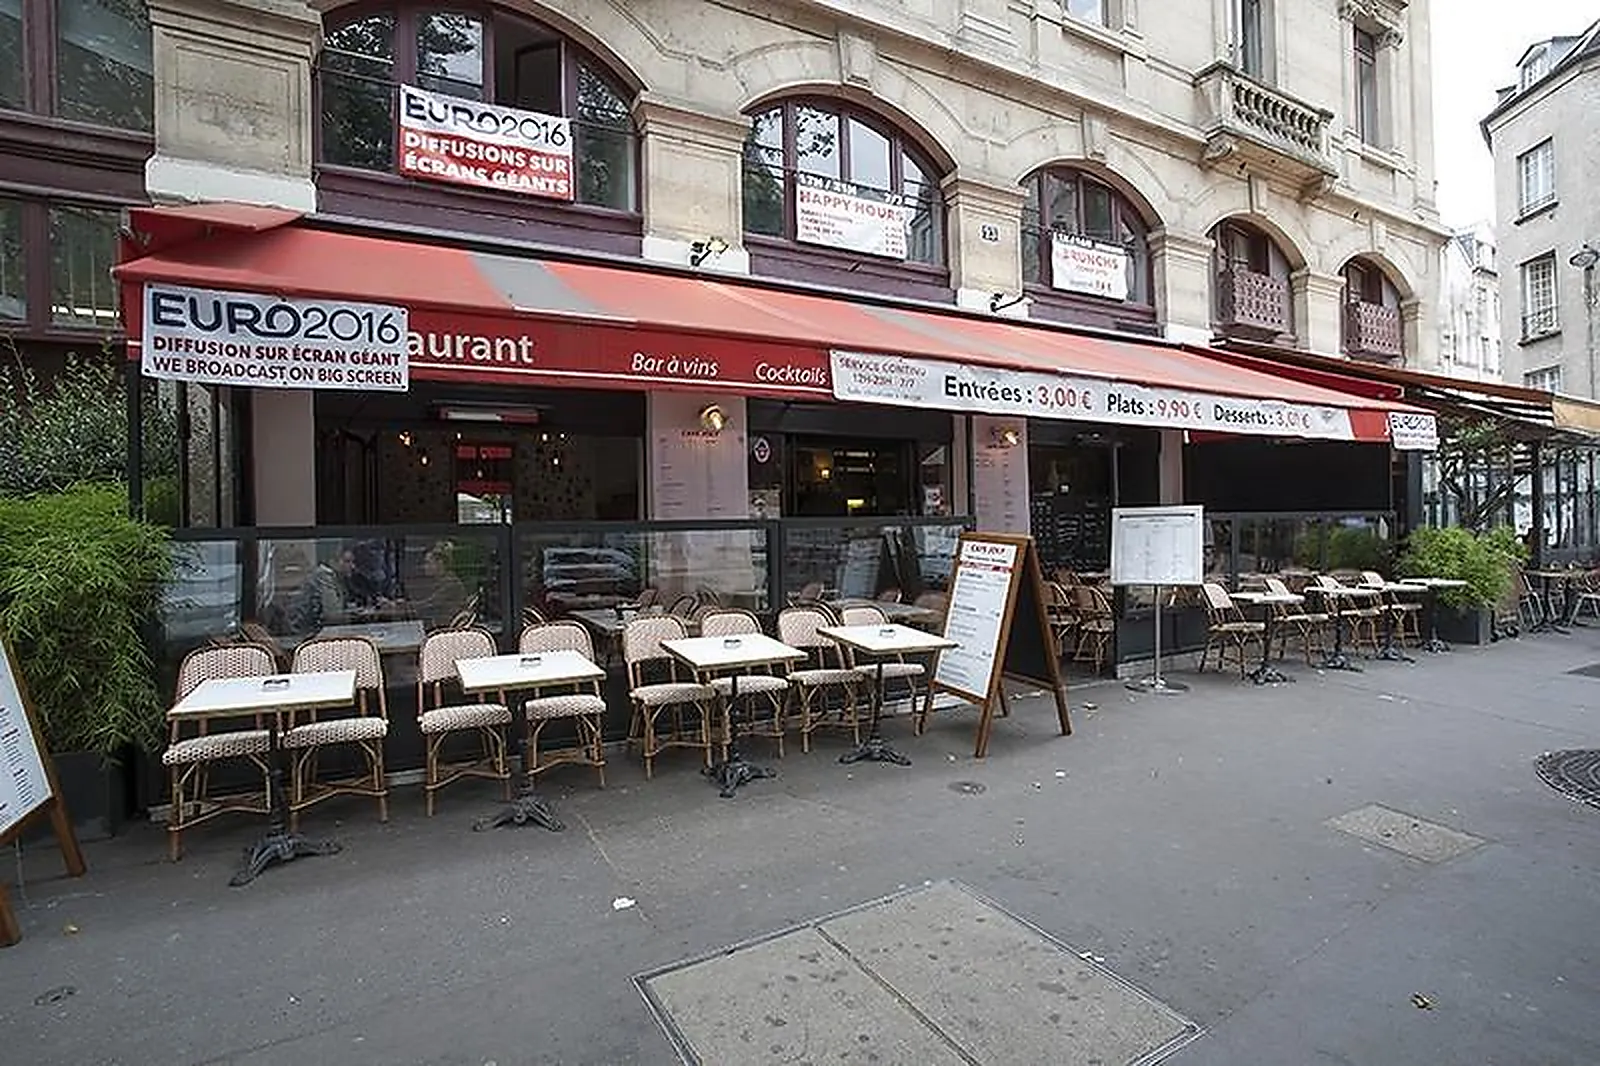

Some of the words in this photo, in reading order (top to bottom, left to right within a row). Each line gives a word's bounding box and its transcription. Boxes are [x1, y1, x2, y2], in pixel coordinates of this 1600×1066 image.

[405, 93, 567, 147] EURO2016
[405, 133, 528, 167] DIFFUSIONS
[530, 155, 568, 174] SUR
[405, 152, 488, 182] ÉCRANS
[493, 172, 569, 194] GÉANTS
[800, 191, 851, 211] HAPPY
[855, 202, 904, 222] HOURS
[152, 292, 400, 344] EURO2016
[153, 336, 251, 359] DIFFUSION
[255, 345, 288, 361] SUR
[292, 341, 346, 363] ÉCRAN
[350, 347, 401, 366] GÉANT
[632, 353, 663, 373] Bar
[667, 355, 679, 374] à
[683, 358, 719, 377] vins
[153, 357, 181, 372] WE
[185, 358, 285, 380] BROADCAST
[289, 366, 314, 380] ON
[318, 369, 343, 382] BIG
[346, 370, 401, 384] SCREEN
[755, 362, 826, 384] Cocktails
[1038, 386, 1076, 409] 3,00
[1081, 391, 1092, 410] €
[1157, 399, 1189, 419] 9,90
